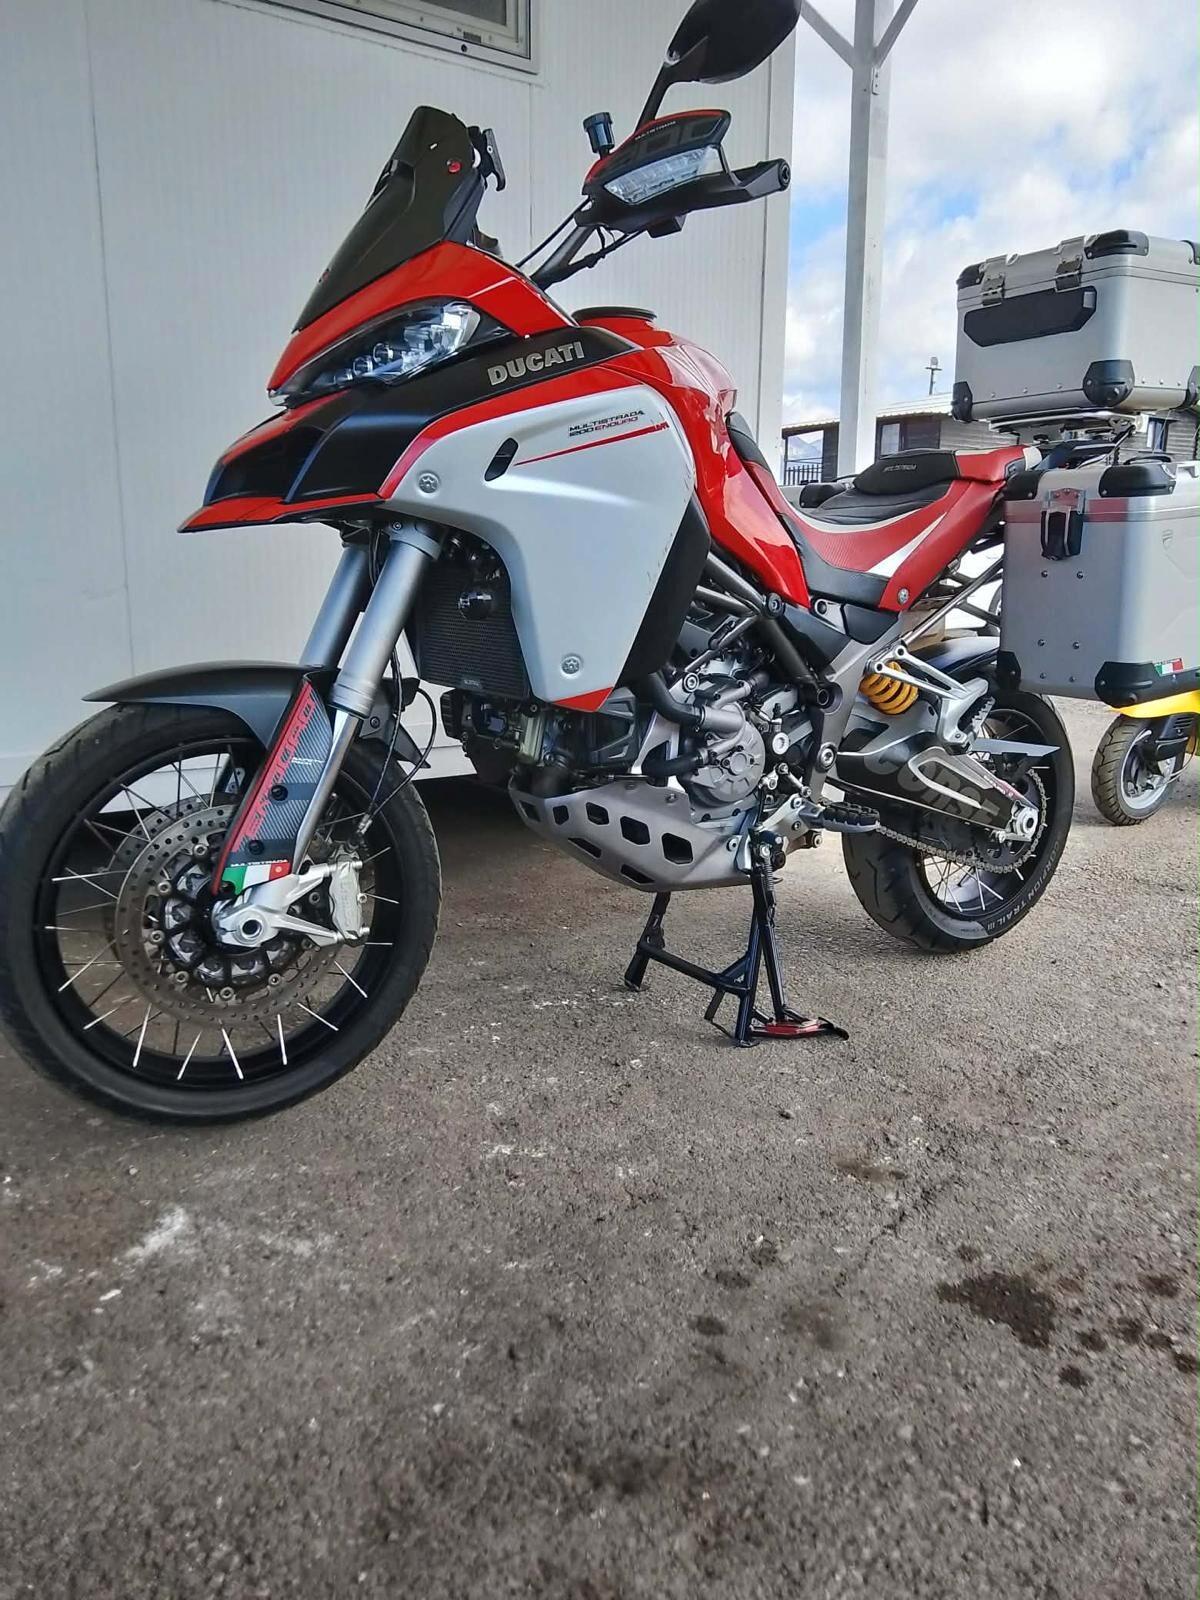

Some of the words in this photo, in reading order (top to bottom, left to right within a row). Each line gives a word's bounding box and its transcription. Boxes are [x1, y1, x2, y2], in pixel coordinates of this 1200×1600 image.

[487, 341, 585, 386] DUCATI
[569, 410, 645, 432] MULTISTRADA
[569, 427, 594, 437] 1200
[594, 416, 639, 431] ENDURO
[998, 902, 1030, 928] TRAIL
